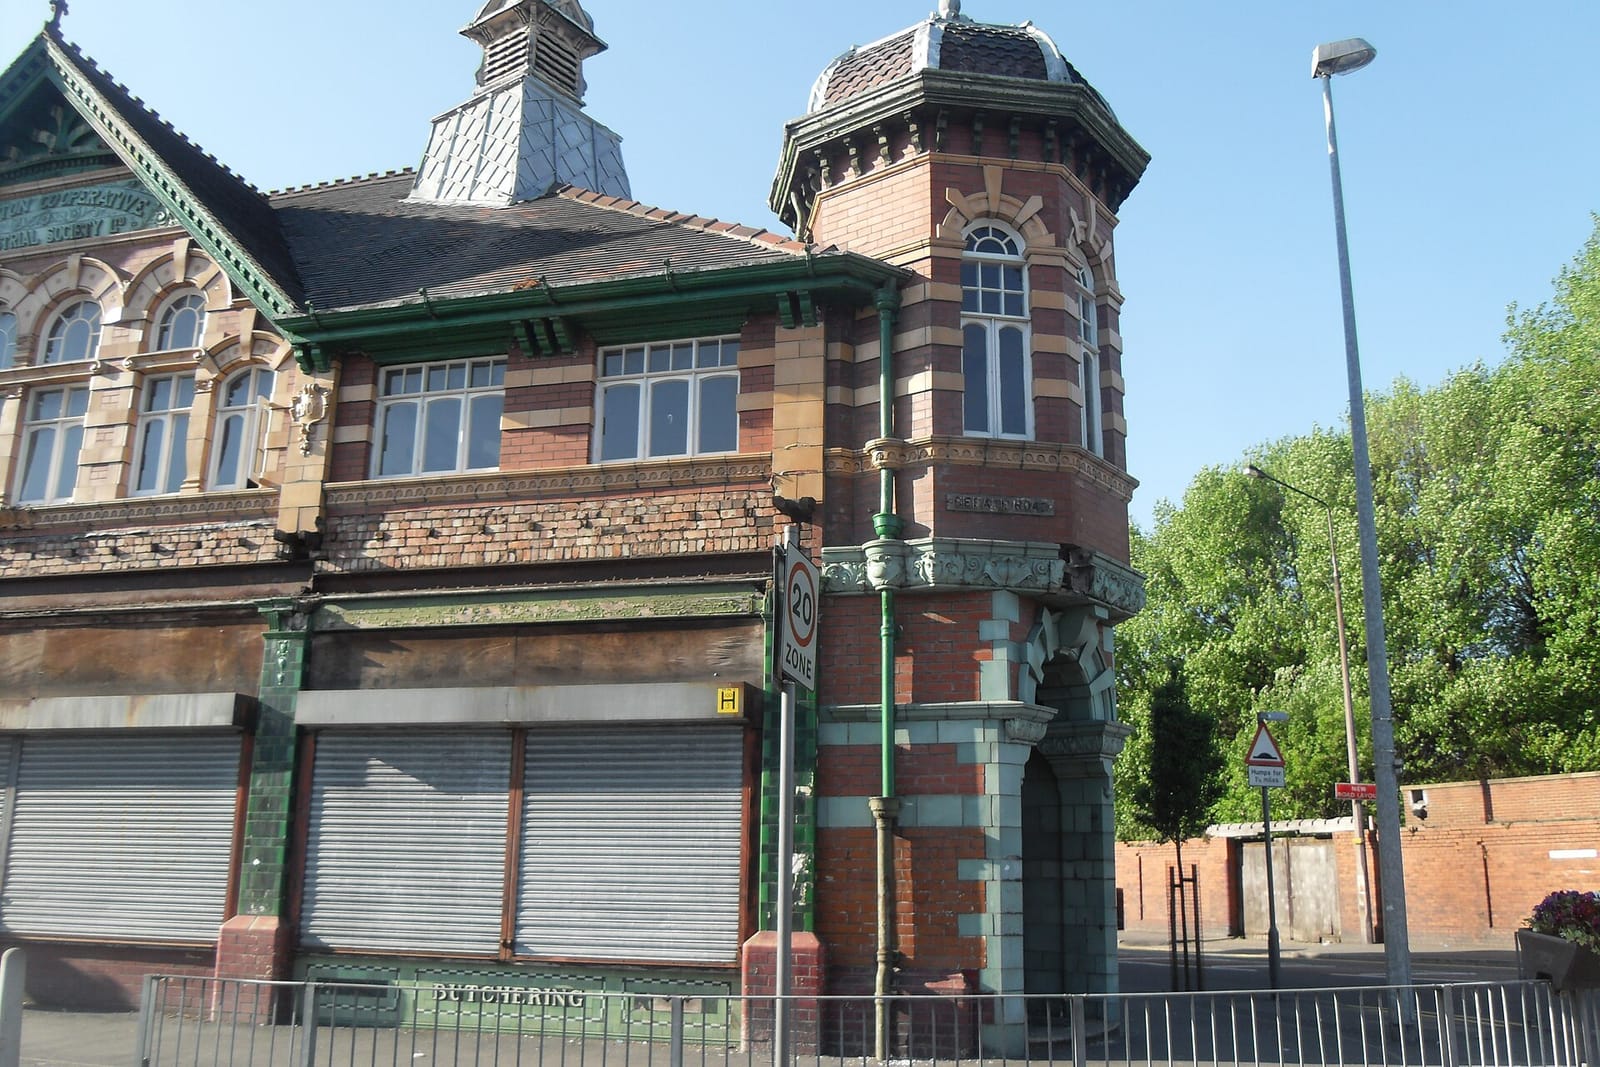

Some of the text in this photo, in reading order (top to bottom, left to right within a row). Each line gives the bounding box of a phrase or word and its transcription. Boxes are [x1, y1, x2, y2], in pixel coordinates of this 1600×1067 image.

[46, 219, 104, 244] SOCIETY
[792, 583, 812, 626] 20
[786, 643, 812, 680] ZONE
[721, 690, 735, 710] H
[432, 983, 585, 1007] BUTCHERING
